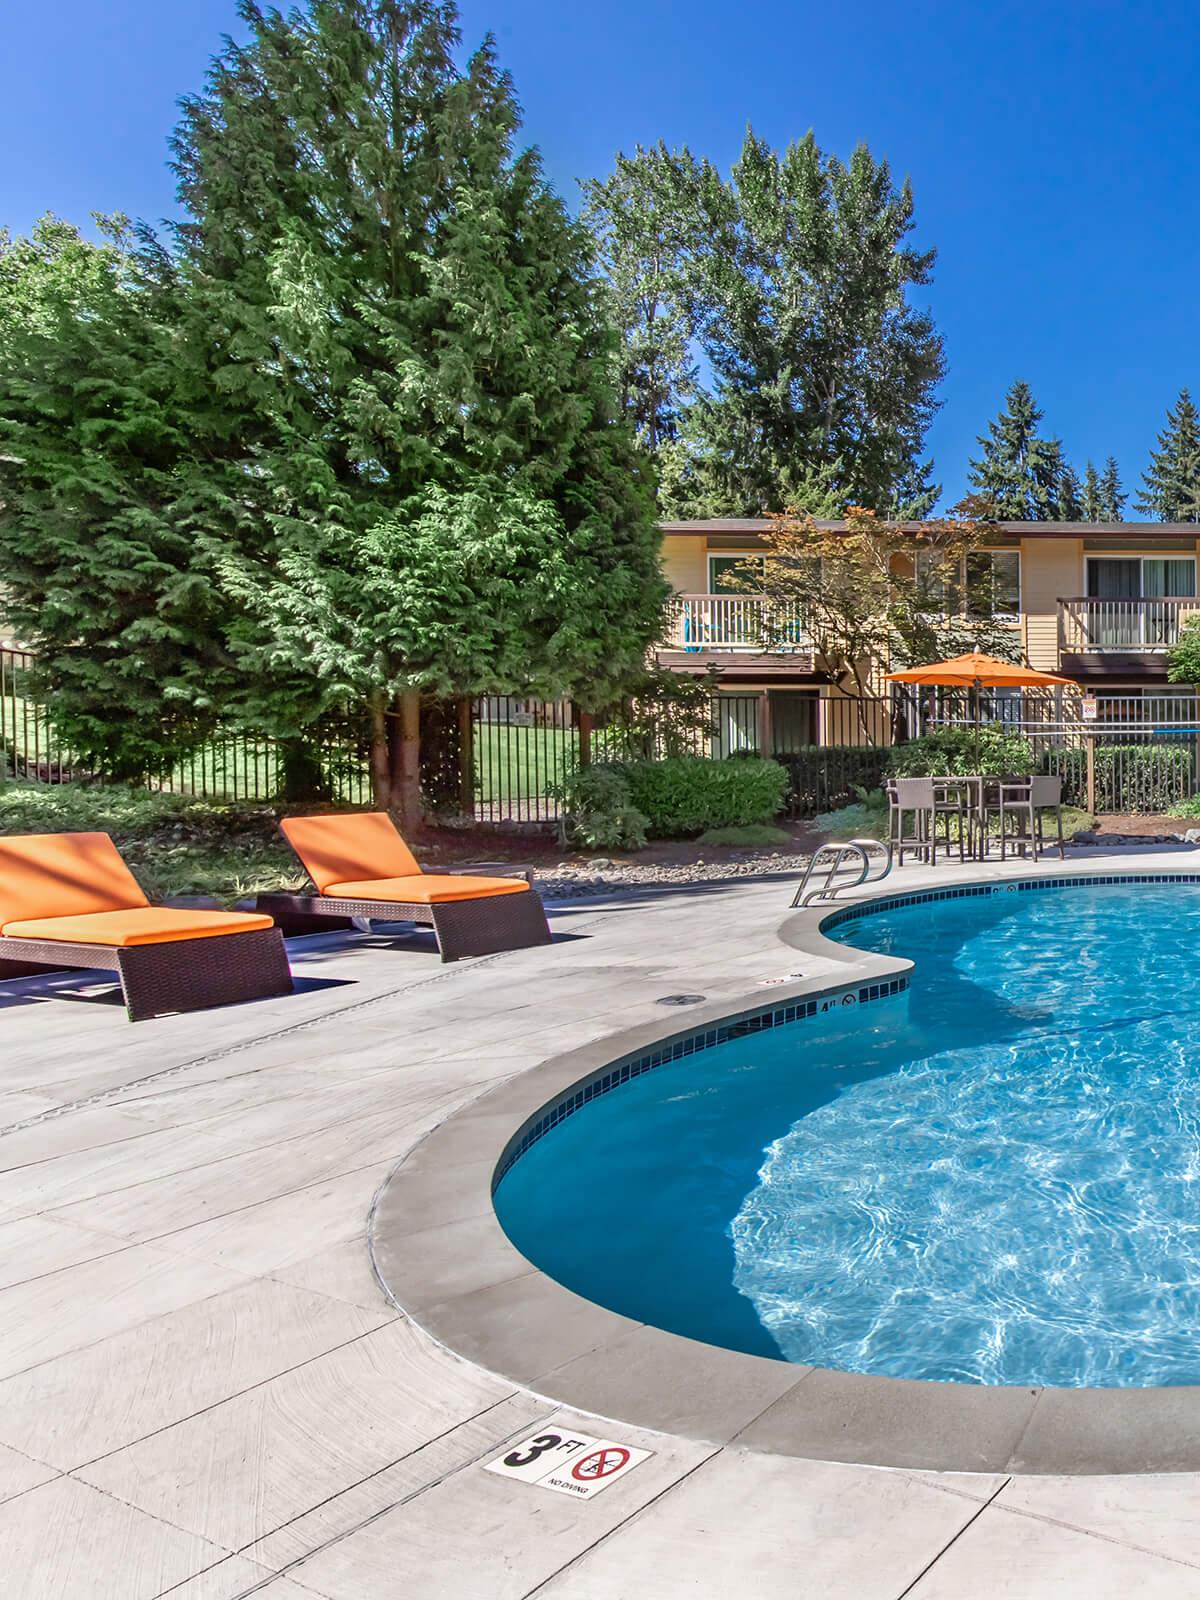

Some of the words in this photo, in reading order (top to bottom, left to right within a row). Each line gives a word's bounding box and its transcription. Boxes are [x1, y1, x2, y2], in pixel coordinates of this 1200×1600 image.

[503, 1434, 562, 1467] 3
[556, 1439, 587, 1454] FT
[548, 1478, 562, 1486] NO
[561, 1482, 589, 1494] DIVING
